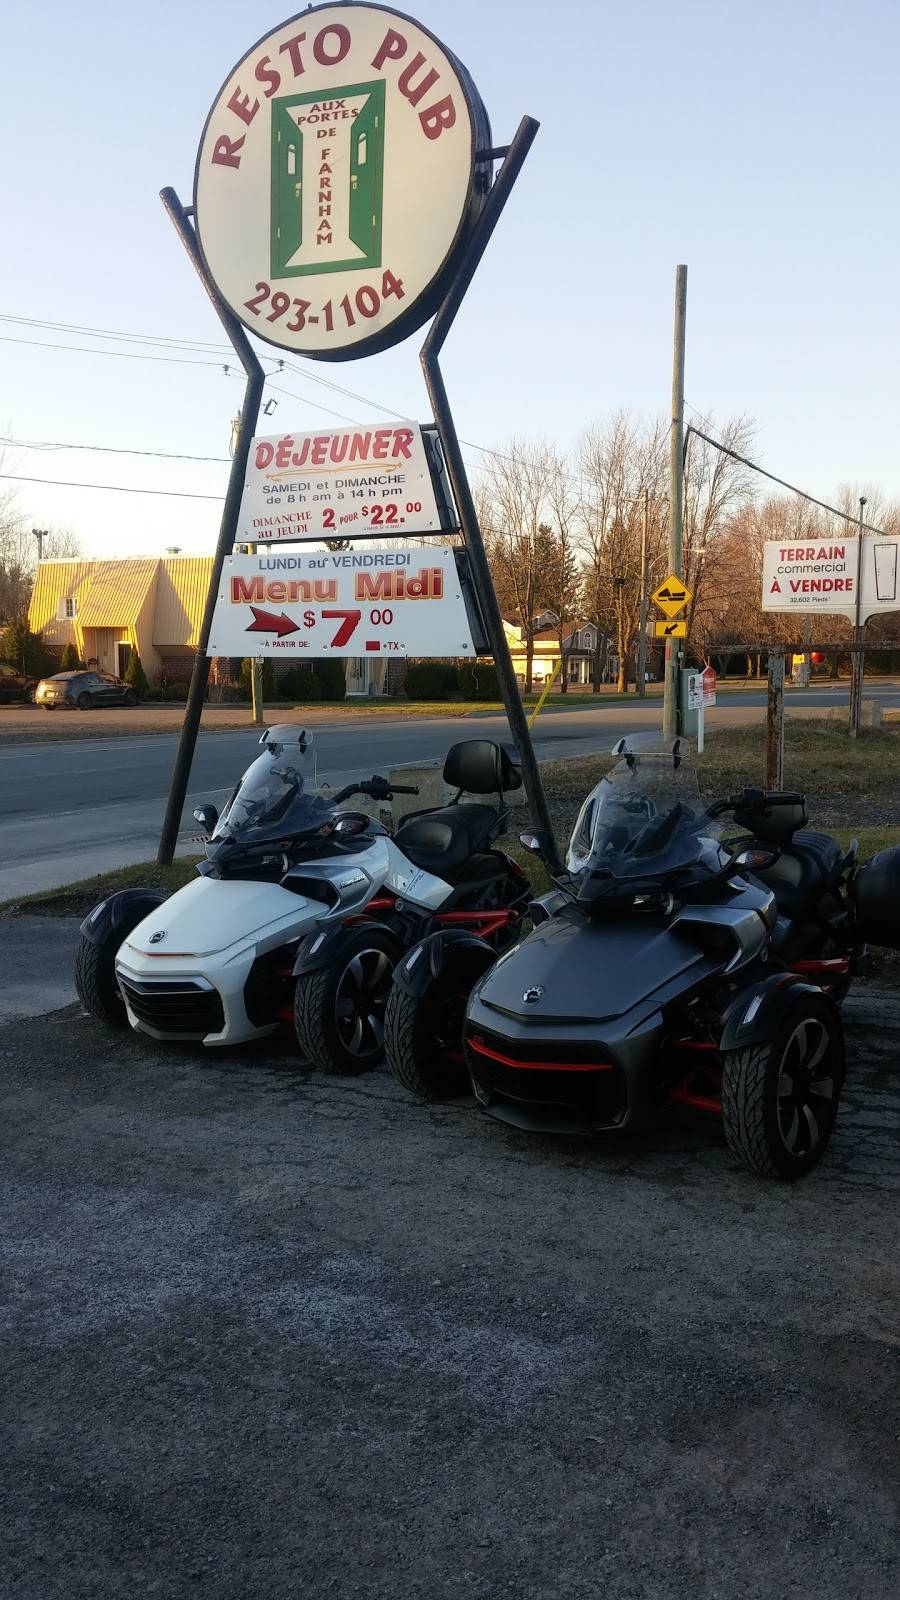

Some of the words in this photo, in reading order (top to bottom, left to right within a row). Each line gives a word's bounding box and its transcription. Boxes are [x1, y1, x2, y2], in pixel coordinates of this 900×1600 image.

[211, 23, 351, 169] RESTO
[370, 28, 457, 141] PUB
[309, 100, 347, 113] AUX
[297, 108, 358, 125] PORTES
[316, 127, 337, 138] DE
[316, 148, 333, 245] FARNHAM
[243, 269, 406, 332] 293-1104
[255, 428, 415, 470] DÉJEUNER
[262, 482, 311, 494] SAMEDI
[316, 482, 329, 490] et
[335, 474, 406, 489] DIMANCHE
[266, 496, 281, 505] de
[287, 495, 296, 503] 8
[299, 494, 306, 502] h
[312, 494, 331, 502] am
[337, 491, 345, 500] à
[351, 490, 364, 498] 14
[368, 489, 376, 497] h
[382, 488, 403, 498] pm
[252, 510, 312, 528] DIMANCHE
[322, 508, 336, 528] 2
[339, 512, 359, 525] POUR
[258, 530, 273, 539] au
[276, 524, 309, 538] JEUDI
[258, 558, 301, 570] LUNDI
[332, 553, 411, 568] VENDREDI
[779, 546, 846, 562] TERRAIN
[777, 562, 846, 574] commercial
[230, 575, 338, 604] Menu
[354, 567, 444, 601] Midi
[770, 576, 781, 593] À
[789, 578, 853, 593] VENDRE
